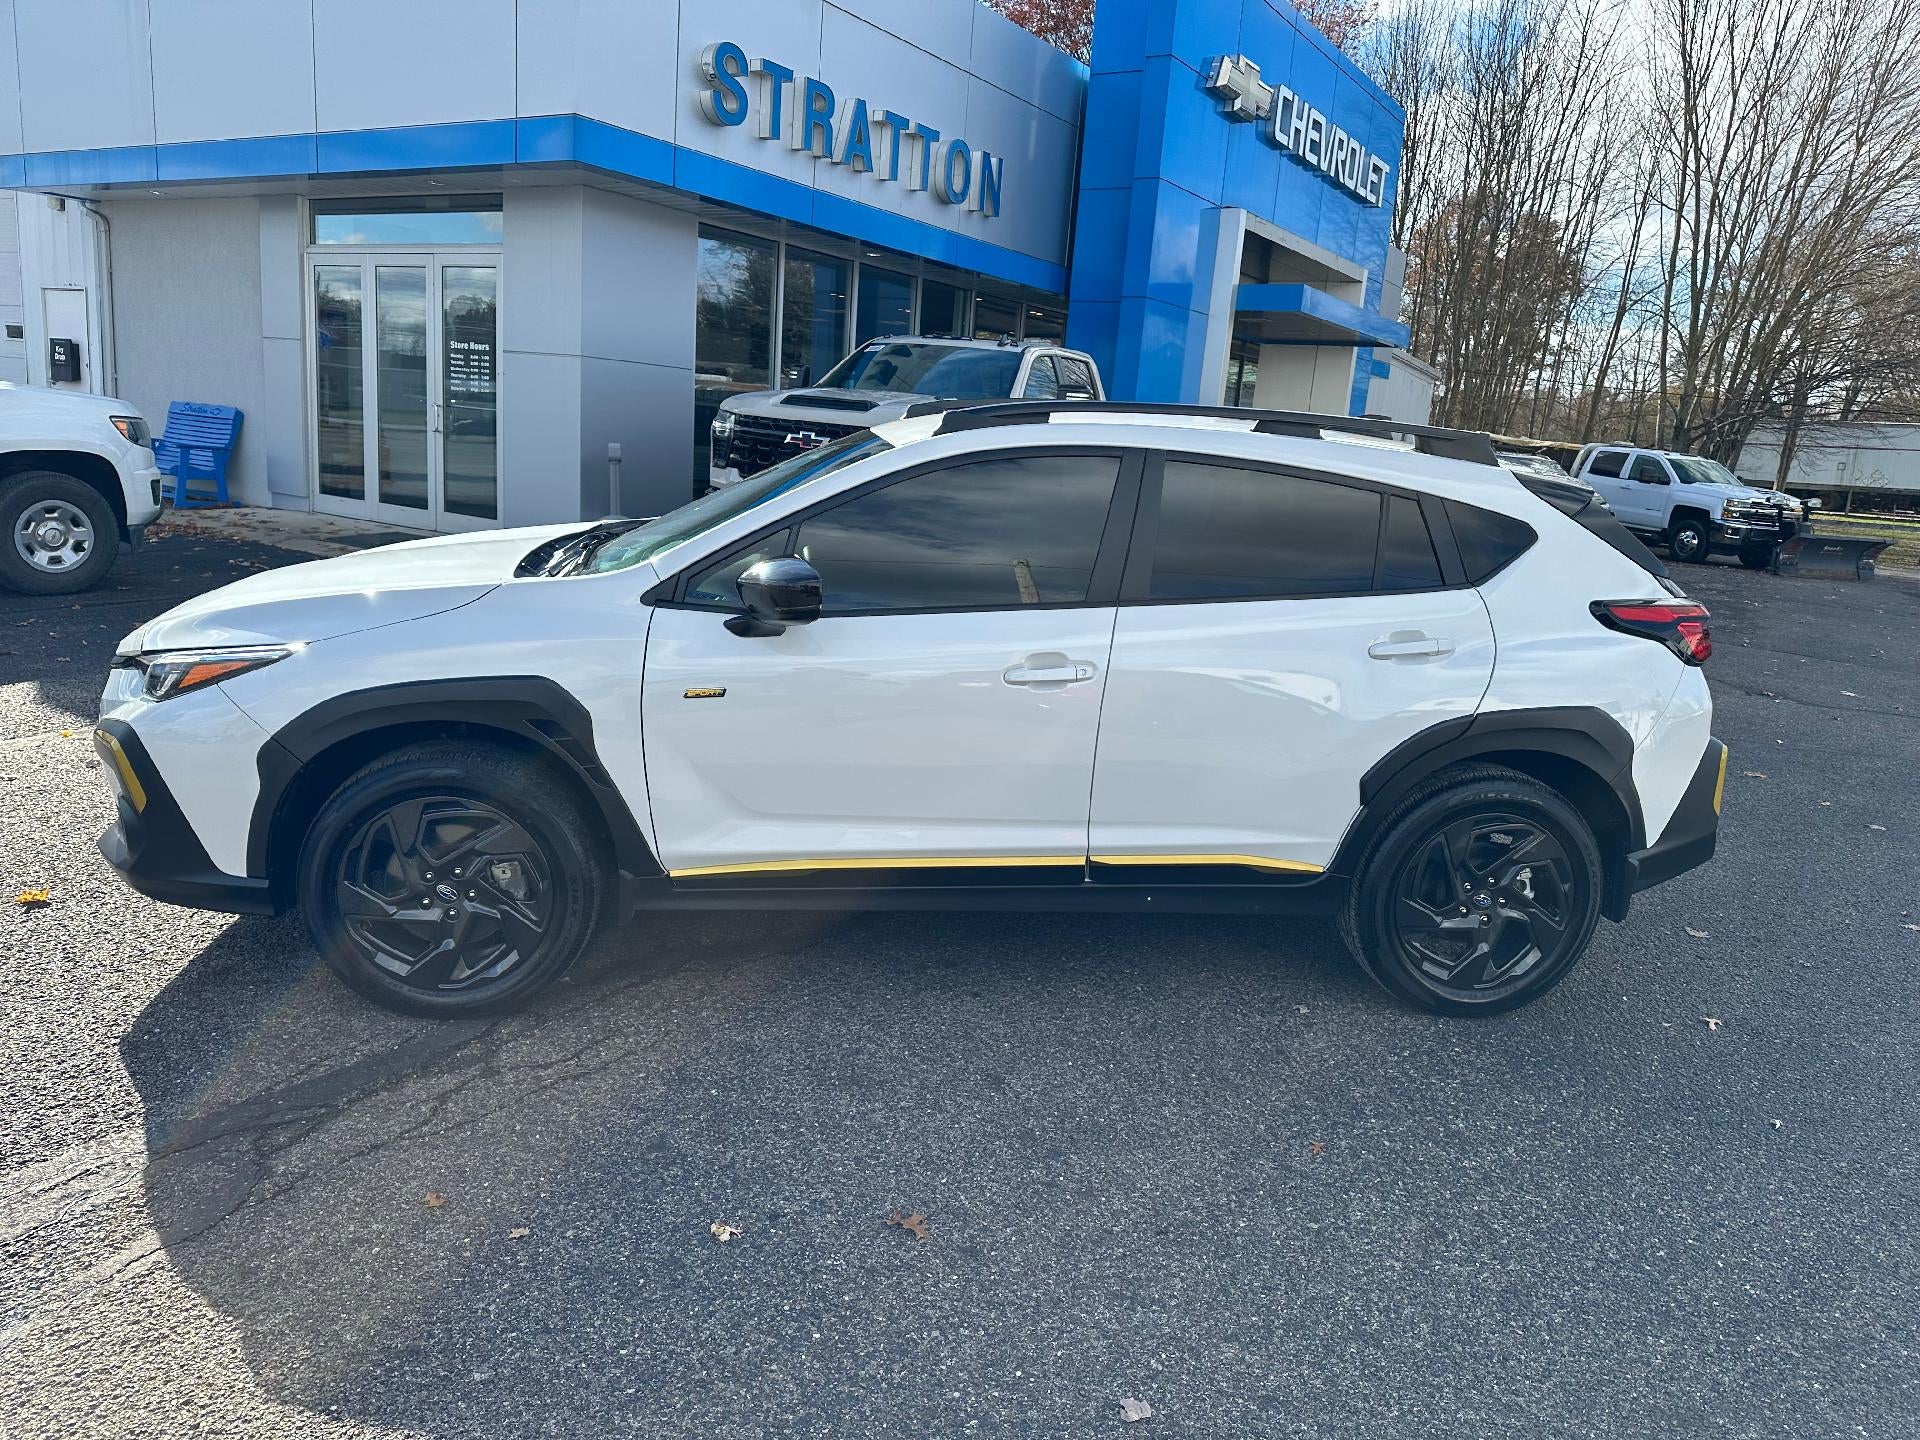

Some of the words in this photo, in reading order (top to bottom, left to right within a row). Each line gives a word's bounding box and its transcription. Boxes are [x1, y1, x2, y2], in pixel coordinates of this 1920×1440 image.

[700, 42, 1003, 217] STRATTON
[1275, 84, 1390, 207] CHEVROLET
[55, 345, 64, 354] Key
[450, 340, 469, 350] Store
[470, 342, 490, 351] Hours
[54, 353, 66, 361] Drop
